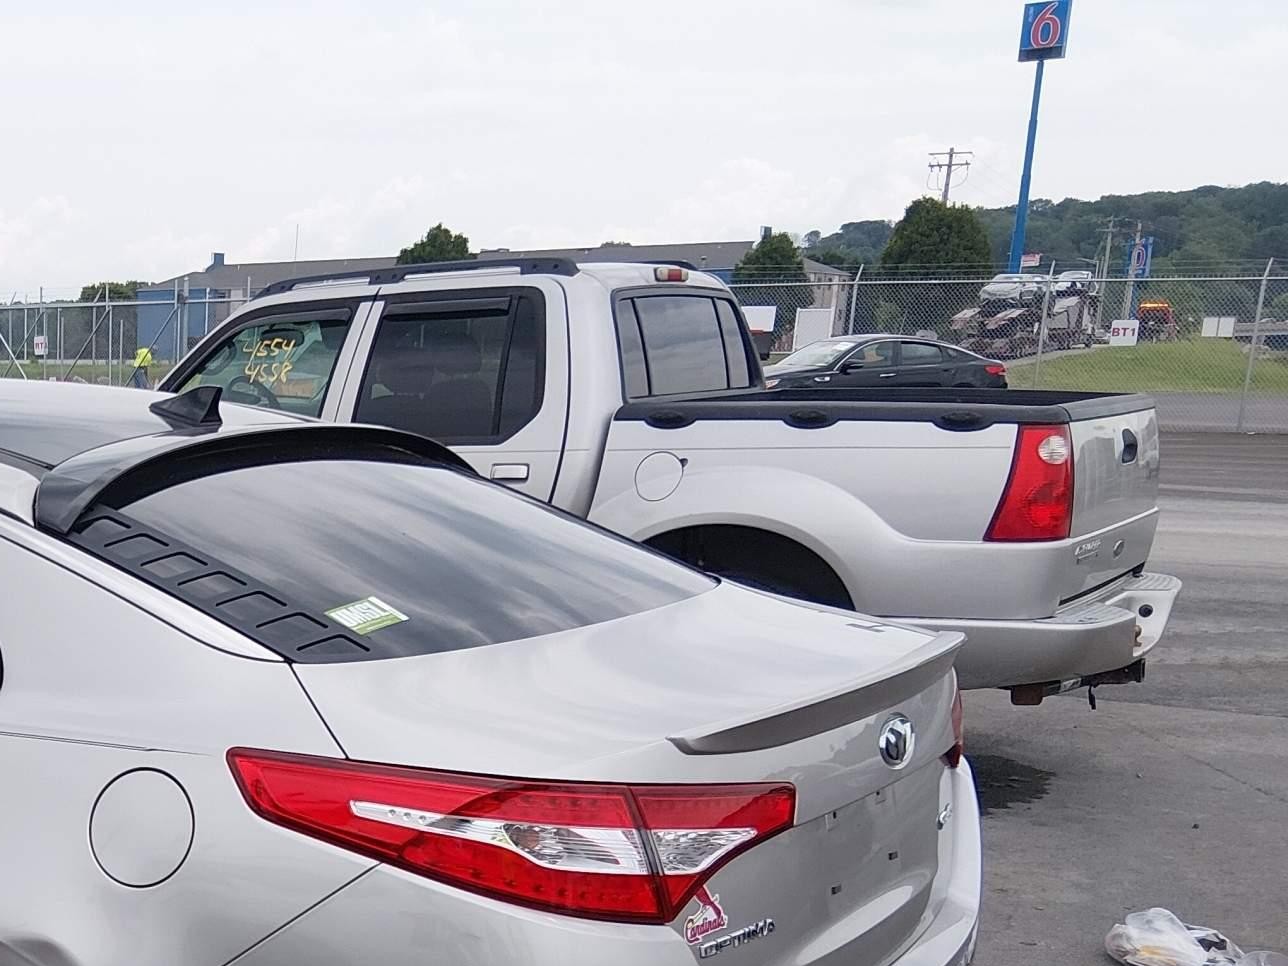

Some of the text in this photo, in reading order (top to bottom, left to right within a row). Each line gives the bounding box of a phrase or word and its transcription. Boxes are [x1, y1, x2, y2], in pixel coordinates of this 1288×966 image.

[1031, 2, 1060, 48] 6
[1112, 327, 1136, 337] BT1
[243, 338, 296, 362] 4554
[245, 362, 293, 384] 4558
[699, 918, 776, 958] OPTIMA
